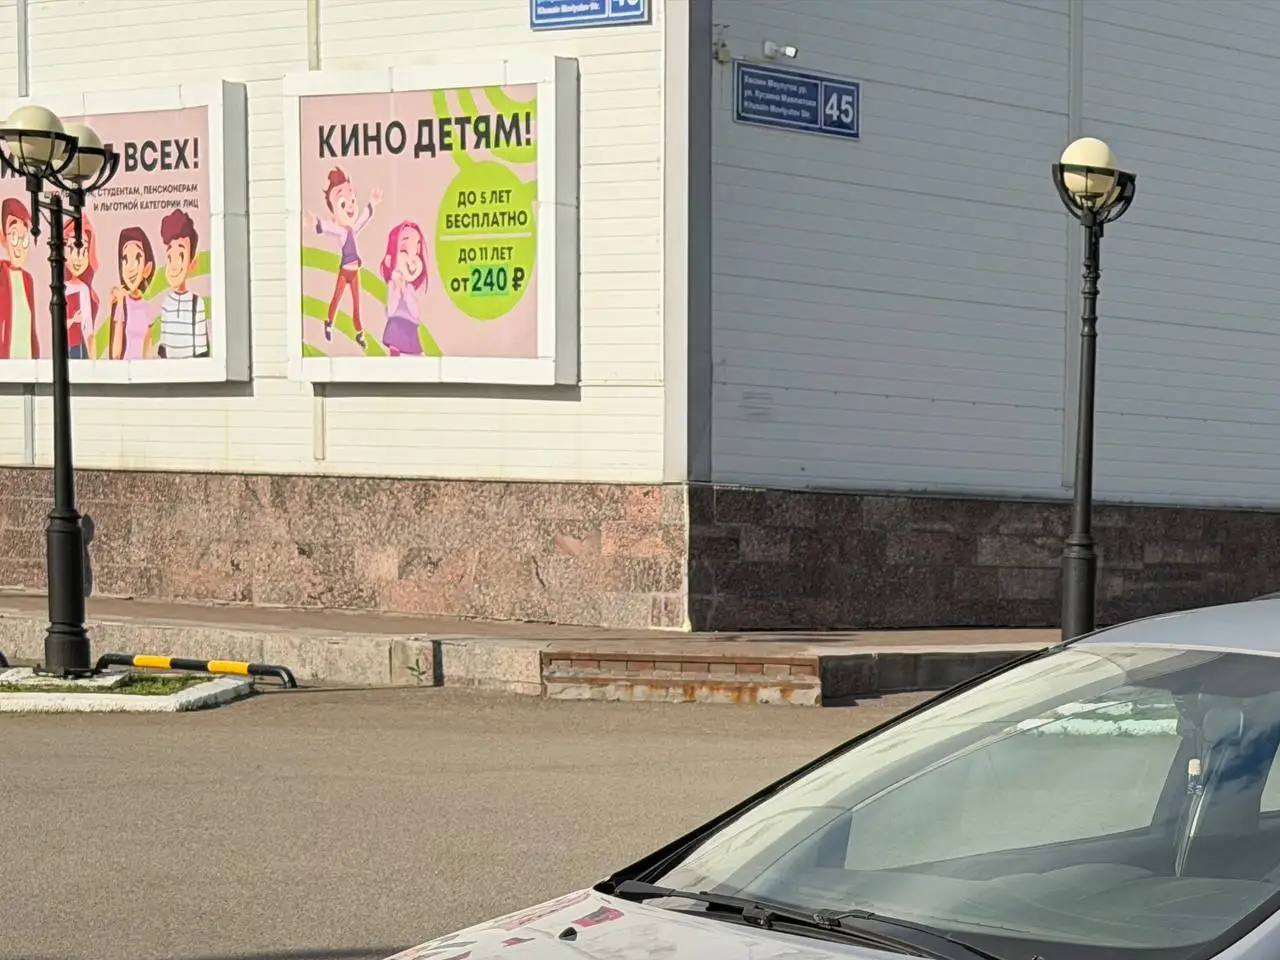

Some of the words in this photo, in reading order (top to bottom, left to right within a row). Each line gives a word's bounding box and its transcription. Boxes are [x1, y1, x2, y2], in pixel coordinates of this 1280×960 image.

[825, 92, 854, 123] 45
[318, 120, 407, 158] КИНО
[413, 111, 532, 159] ДЕТЯМ!
[124, 137, 199, 172] ВСЕХ!
[143, 183, 198, 195] ПЕНСИОНЕРАМ
[457, 190, 477, 208] ДО
[480, 191, 487, 205] 5
[489, 189, 512, 204] ЛЕТ
[100, 199, 139, 212] ЛЬГОТНОЙ
[139, 199, 181, 210] КАТЕГОРИИ
[183, 198, 199, 209] ЛИЦ
[445, 210, 528, 229] БЕСПЛАТНО
[458, 248, 477, 264] ДО
[479, 247, 488, 261] 11
[490, 246, 514, 261] ЛЕТ
[471, 267, 508, 292] 240
